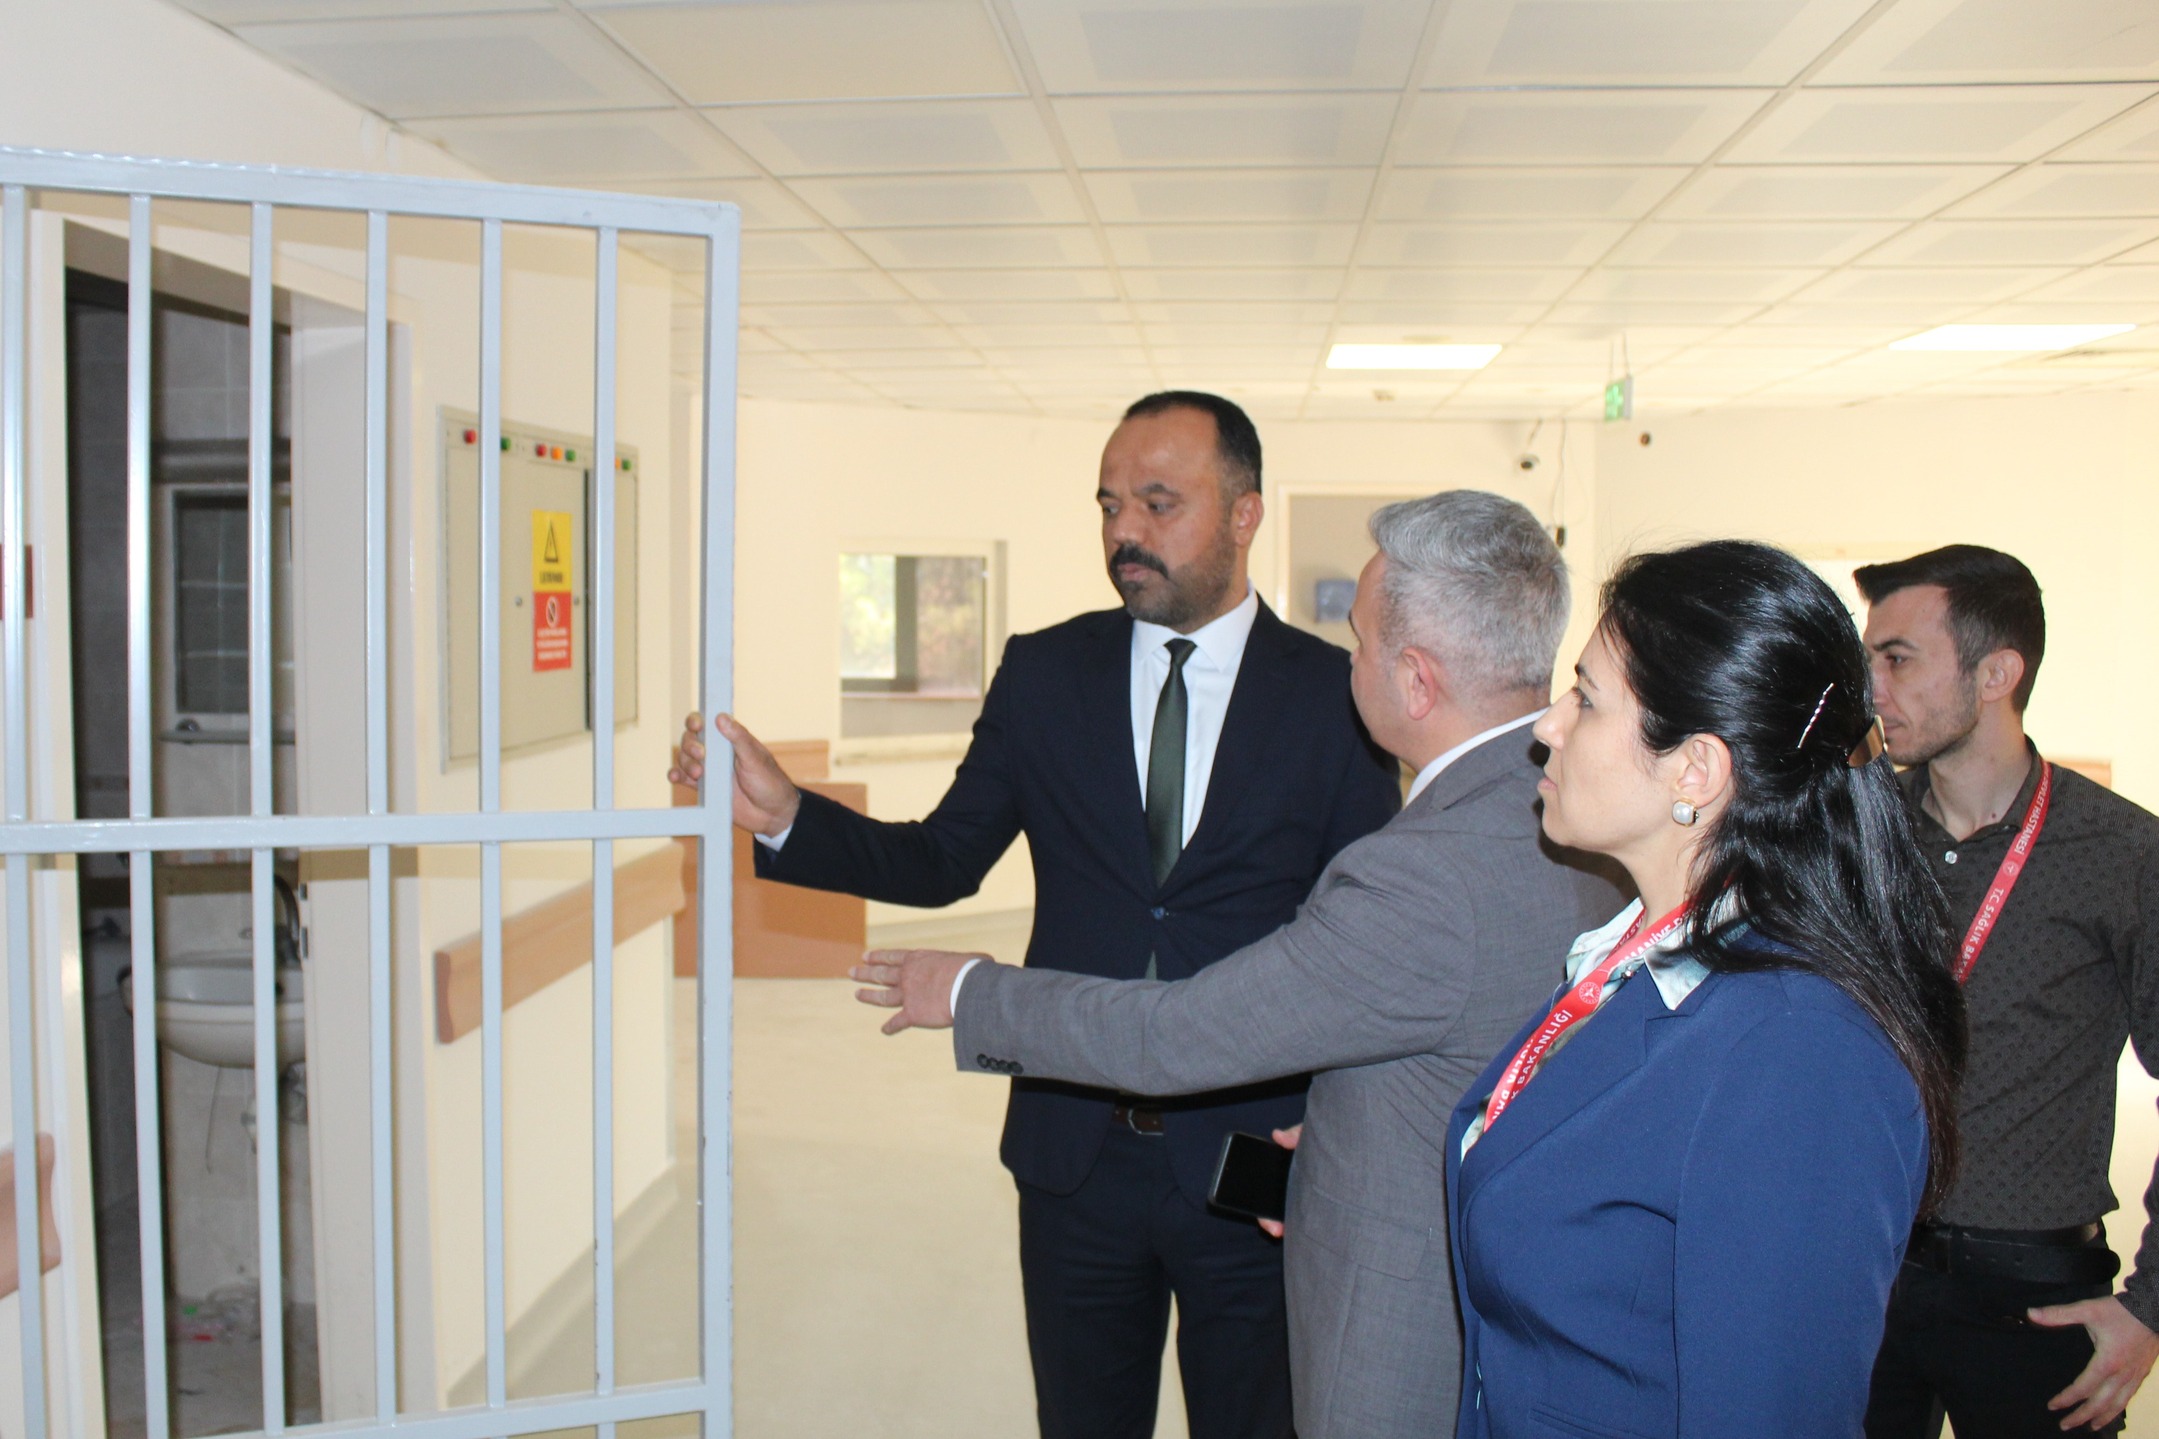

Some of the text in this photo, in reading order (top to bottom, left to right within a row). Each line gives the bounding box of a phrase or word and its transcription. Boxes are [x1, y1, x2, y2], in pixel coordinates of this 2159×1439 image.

[2014, 805, 2042, 855] HASTANESİ
[1969, 904, 1995, 945] SAĞLIK
[1517, 1009, 1573, 1085] BAKANLIĞI
